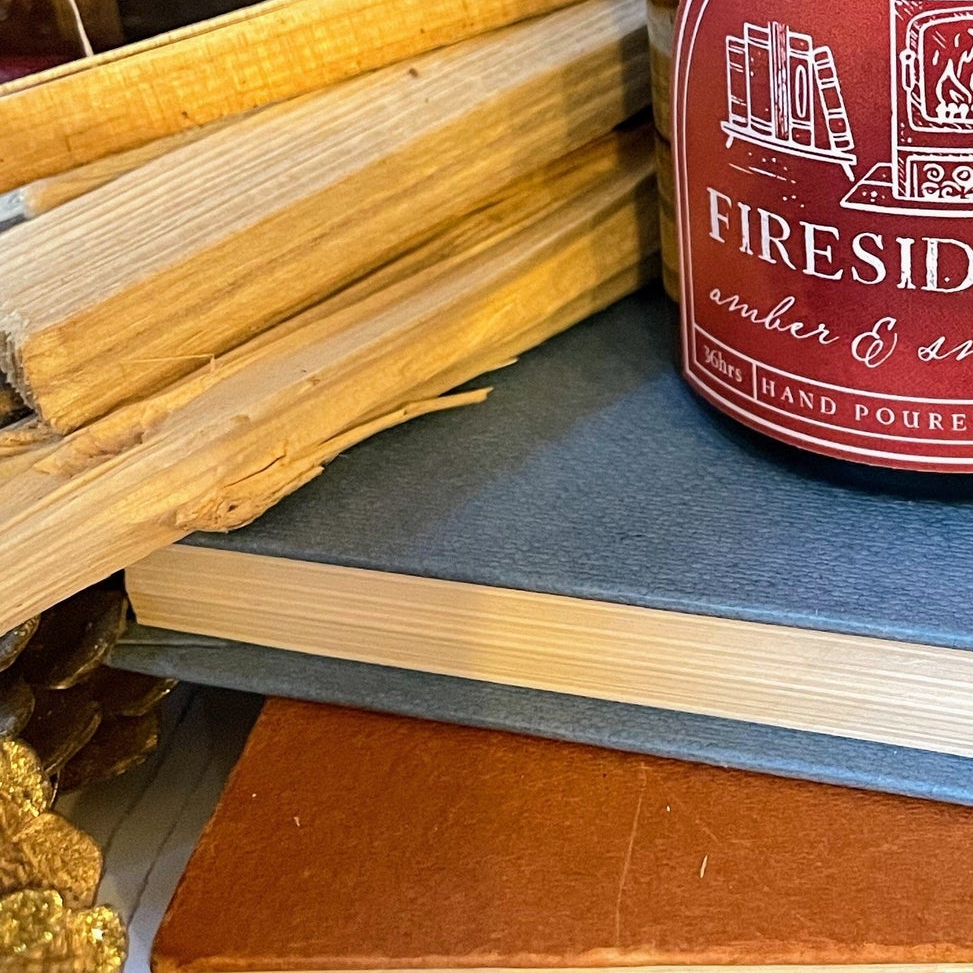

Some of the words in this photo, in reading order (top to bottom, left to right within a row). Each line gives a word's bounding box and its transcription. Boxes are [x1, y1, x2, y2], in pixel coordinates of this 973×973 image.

[709, 288, 840, 345] amber
[851, 316, 898, 369] &
[703, 344, 744, 383] 36hrs
[761, 377, 838, 416] HAND
